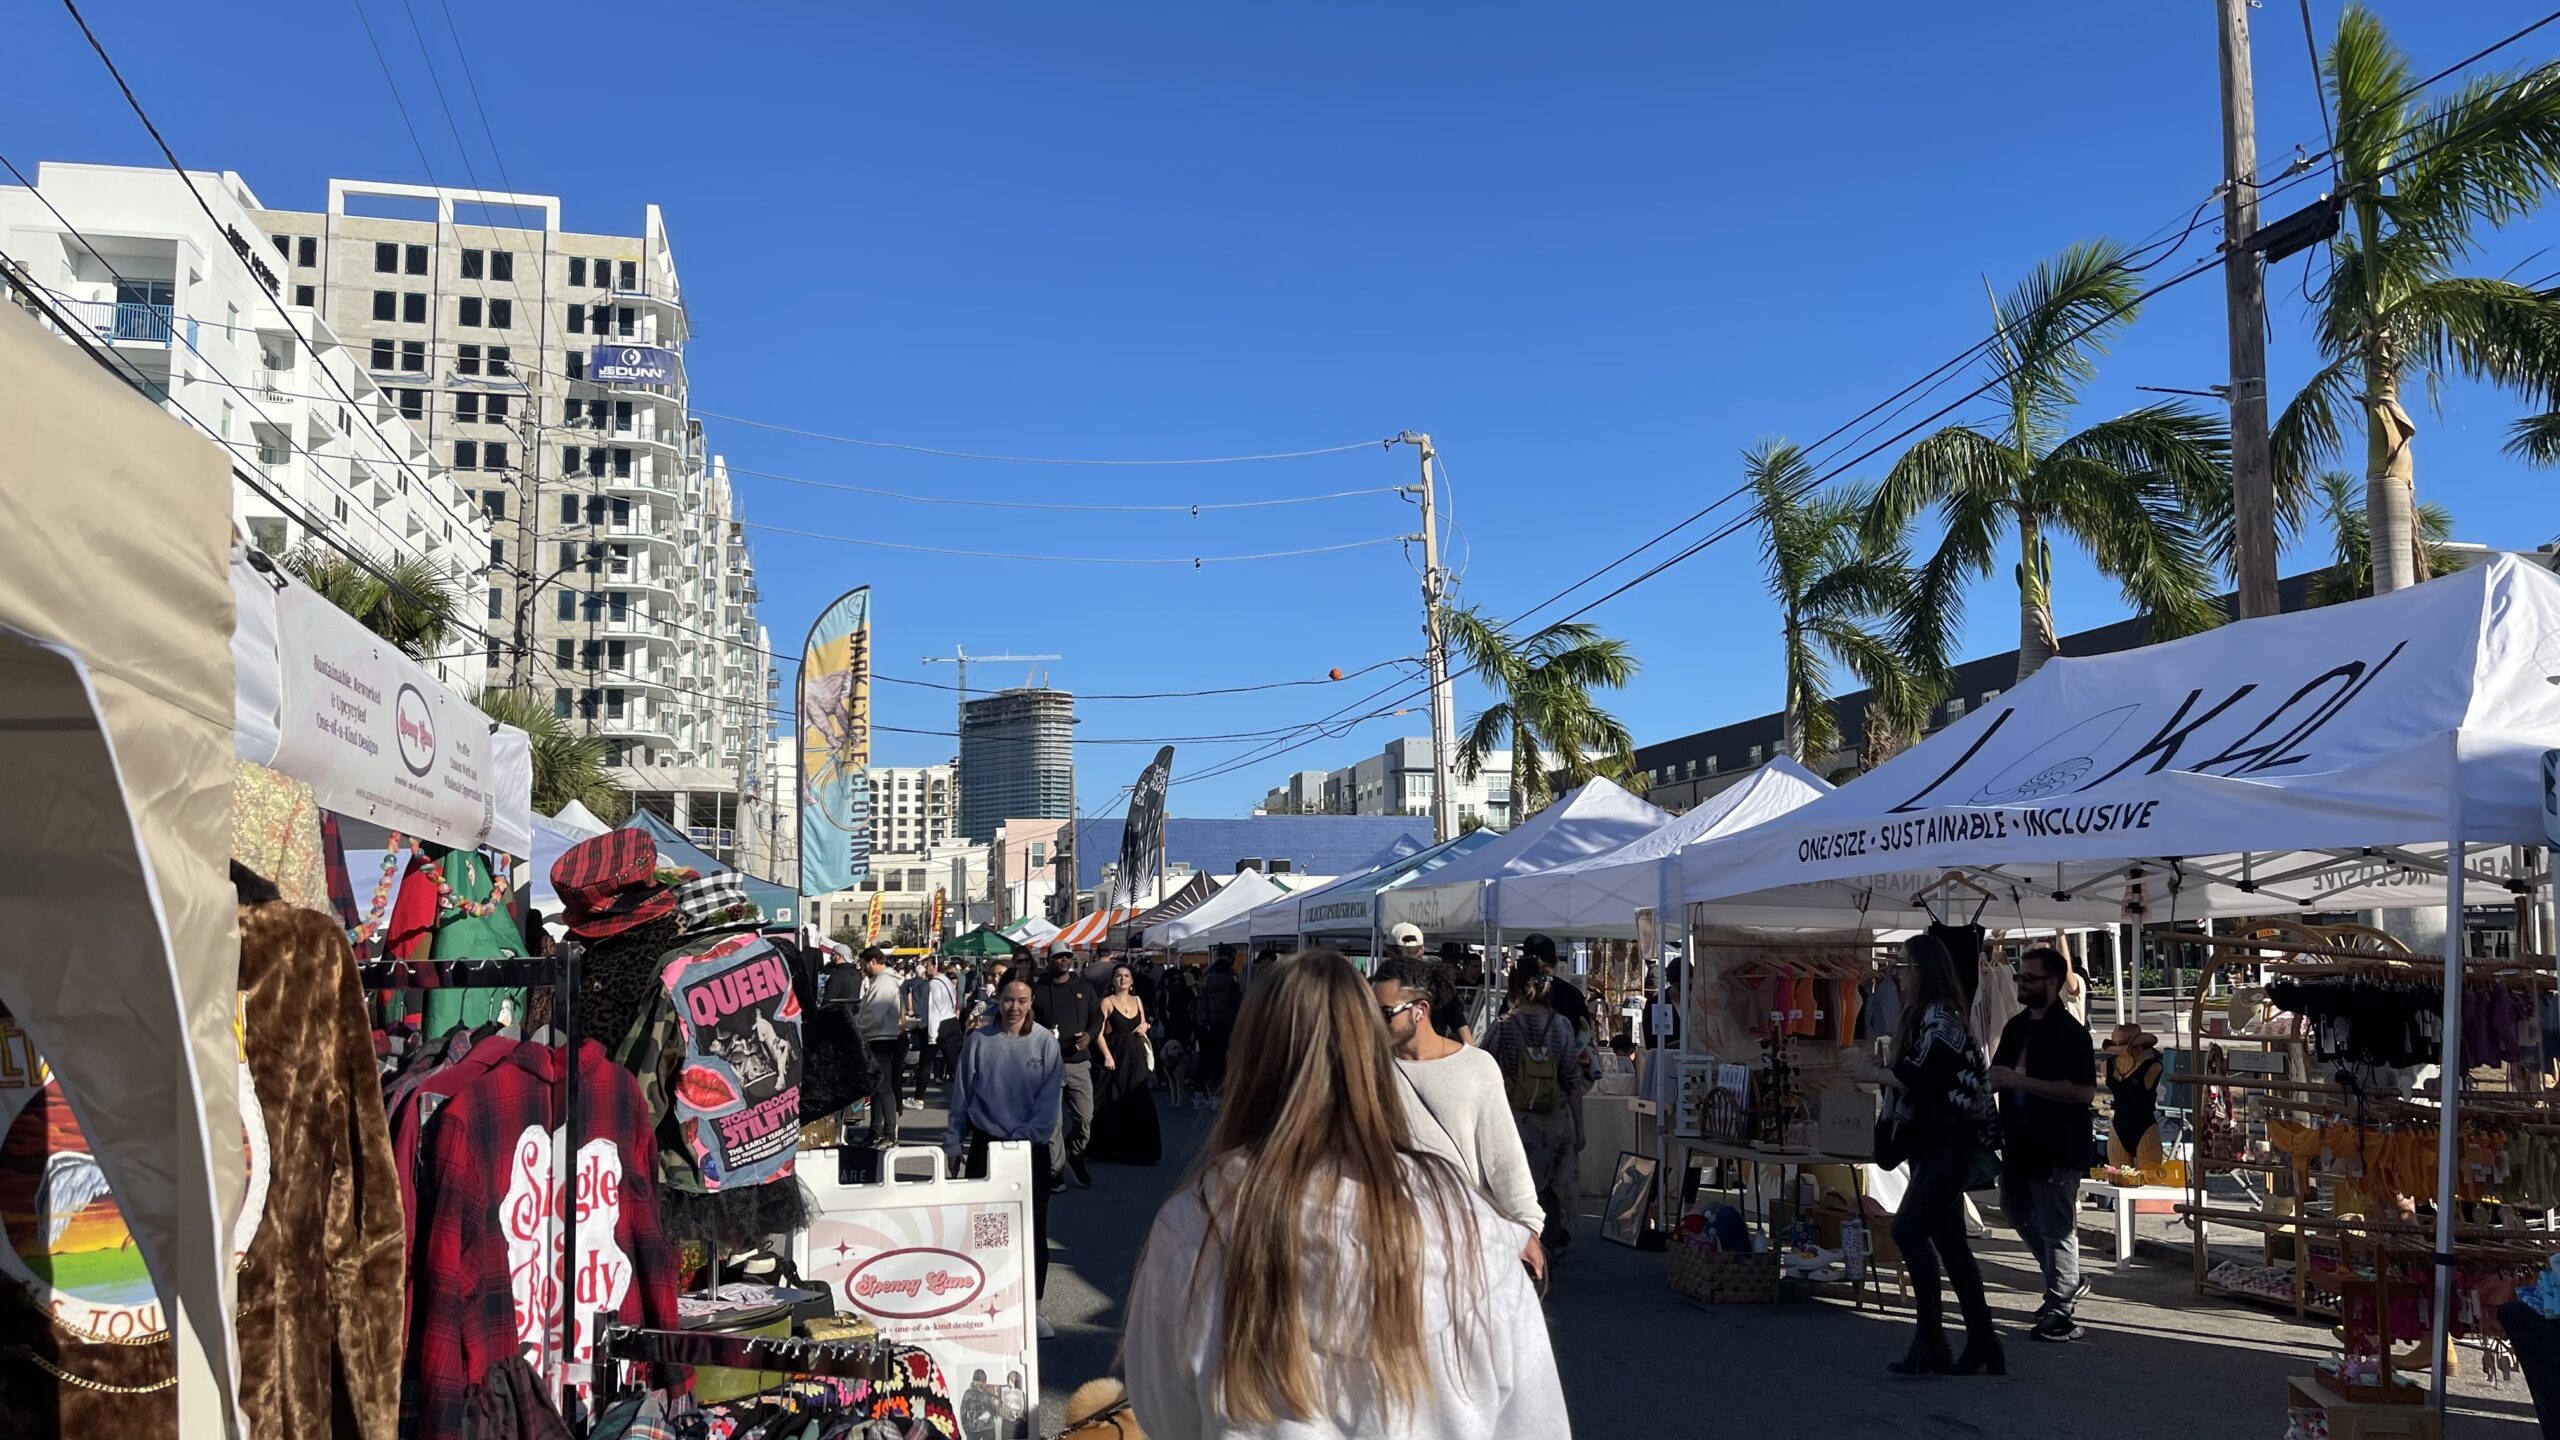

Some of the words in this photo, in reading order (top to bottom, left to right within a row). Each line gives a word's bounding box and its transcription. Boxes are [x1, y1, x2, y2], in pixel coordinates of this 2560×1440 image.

[850, 629, 867, 686] DARK
[359, 733, 379, 757] Designs
[850, 696, 868, 764] CYCLE
[851, 773, 870, 877] CLOTHING
[1798, 829, 1867, 863] ONE/SIZE
[1880, 810, 2007, 851] SUSTAINABLE
[2024, 800, 2160, 838] INCLUSIVE
[688, 956, 788, 1027] QUEEN
[728, 1147, 744, 1157] THE
[745, 1138, 767, 1151] EARLY
[855, 1273, 922, 1298] Spenny
[925, 1269, 975, 1296] Lane
[89, 1305, 156, 1340] TOU
[895, 1322, 952, 1334] one-of-a-kind
[953, 1320, 984, 1330] designs
